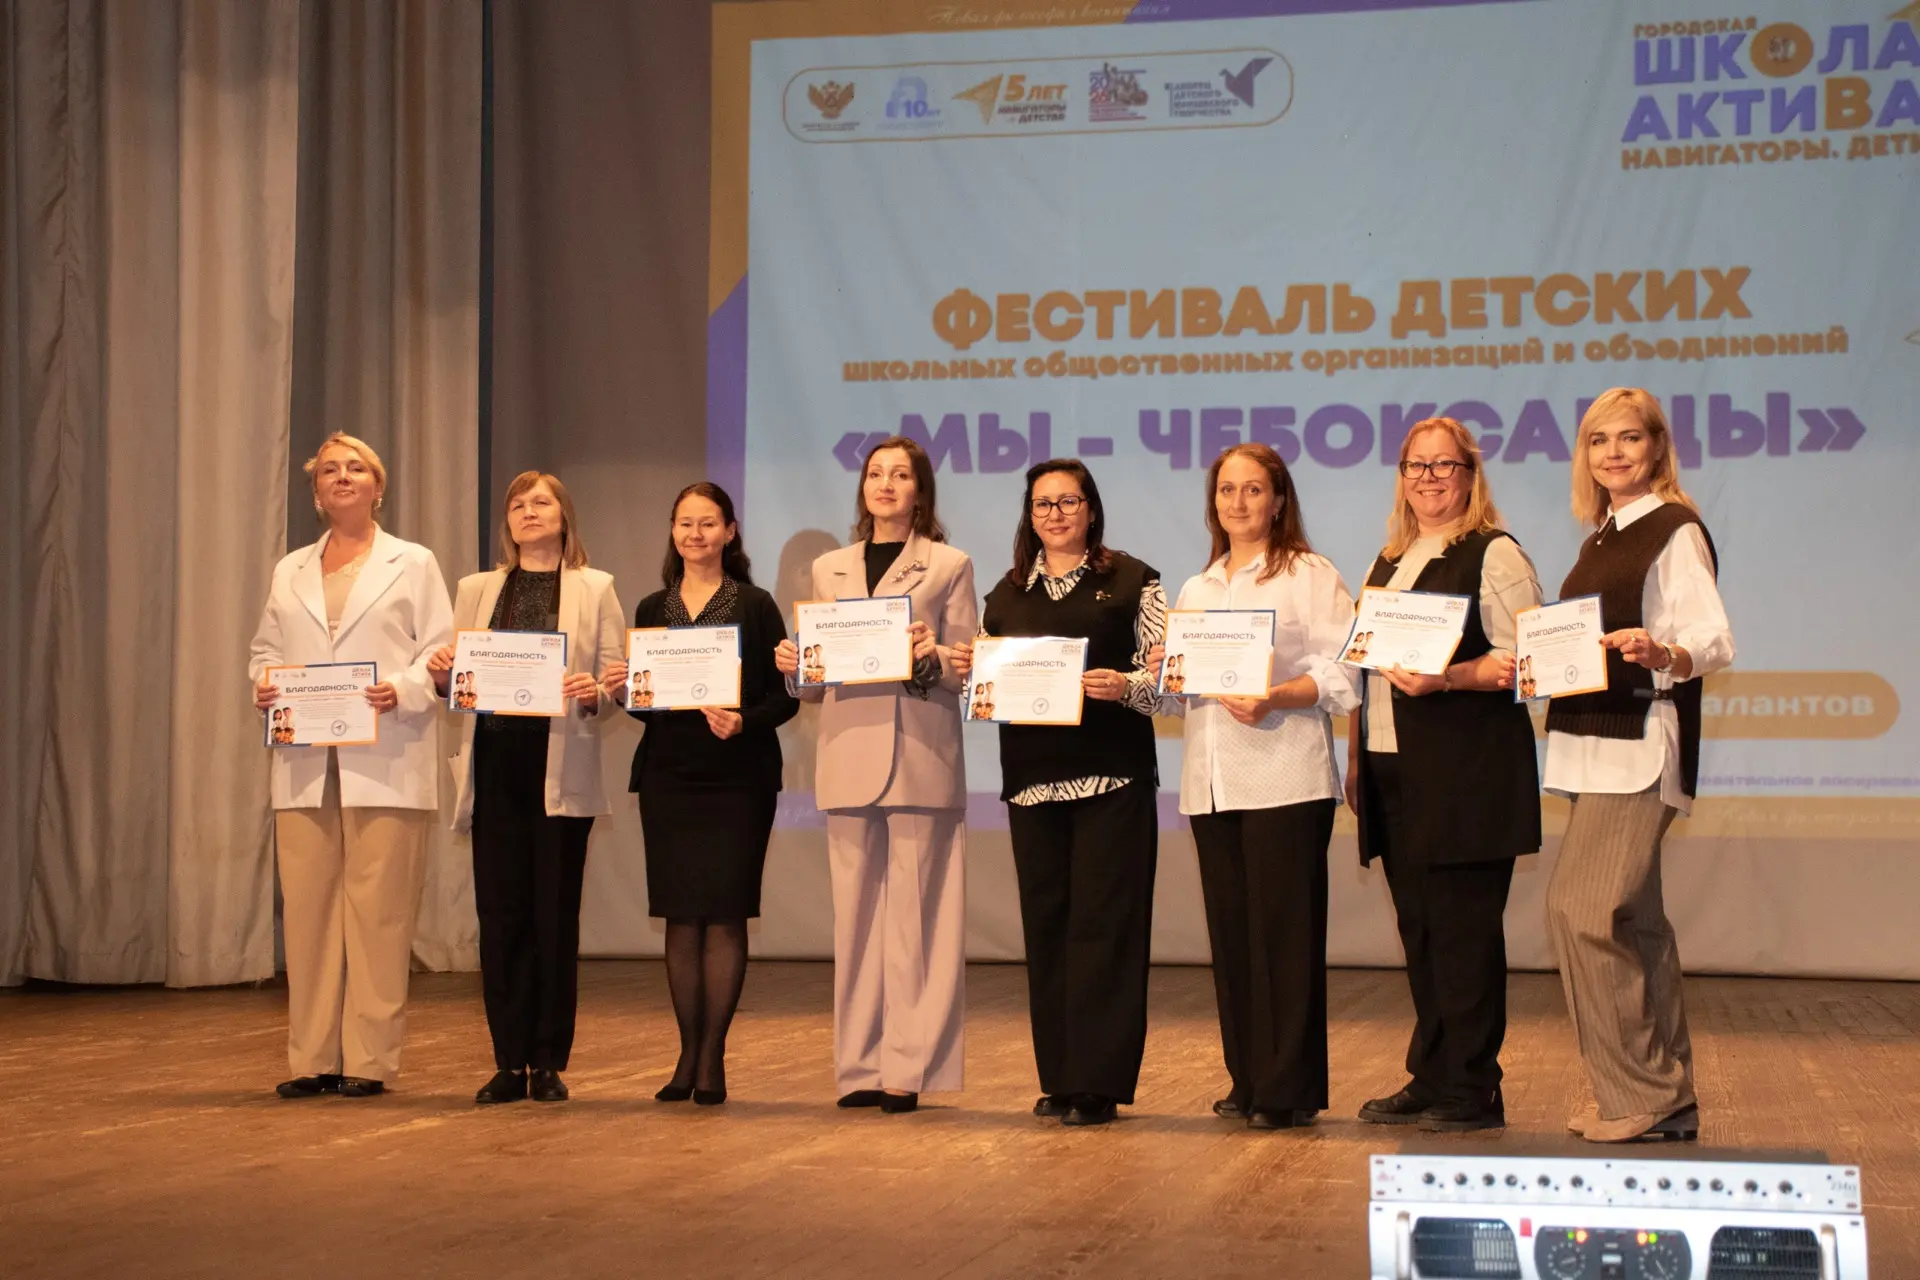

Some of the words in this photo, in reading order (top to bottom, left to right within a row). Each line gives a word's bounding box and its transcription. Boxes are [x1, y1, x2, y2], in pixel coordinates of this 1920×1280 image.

[1633, 17, 1757, 38] ГОРОДСКАЯ
[1633, 21, 1920, 86] ШКОЛА
[1004, 74, 1027, 101] 5
[1027, 84, 1068, 101] ЛЕТ
[903, 100, 928, 118] 10
[1621, 76, 1920, 143] АКТИВА
[1621, 138, 1839, 170] НАВИГАТОРЫ.
[932, 284, 1376, 350] ФЕСТИВАЛЬ
[1390, 267, 1751, 339] ДЕТСКИХ
[842, 356, 1016, 382] школьных
[1024, 349, 1294, 380] общественных
[1302, 336, 1543, 377] организаций
[1554, 342, 1574, 363] и
[1585, 326, 1849, 363] объединений
[816, 619, 893, 630] БЛАГОДАРНОСТЬ
[1375, 611, 1448, 624] БЛАГОДАРНОСТЬ
[1182, 632, 1256, 640] БЛАГОДАРНОСТЬ
[1526, 622, 1586, 639] БЛАГОДАРНОСТЬ
[469, 650, 547, 660] БЛАГОДАРНОСТЬ
[646, 647, 722, 656] БЛАГОДАРНОСТЬ
[285, 684, 359, 694] БЛАГОДАРНОСТЬ
[1702, 695, 1875, 717] алантов
